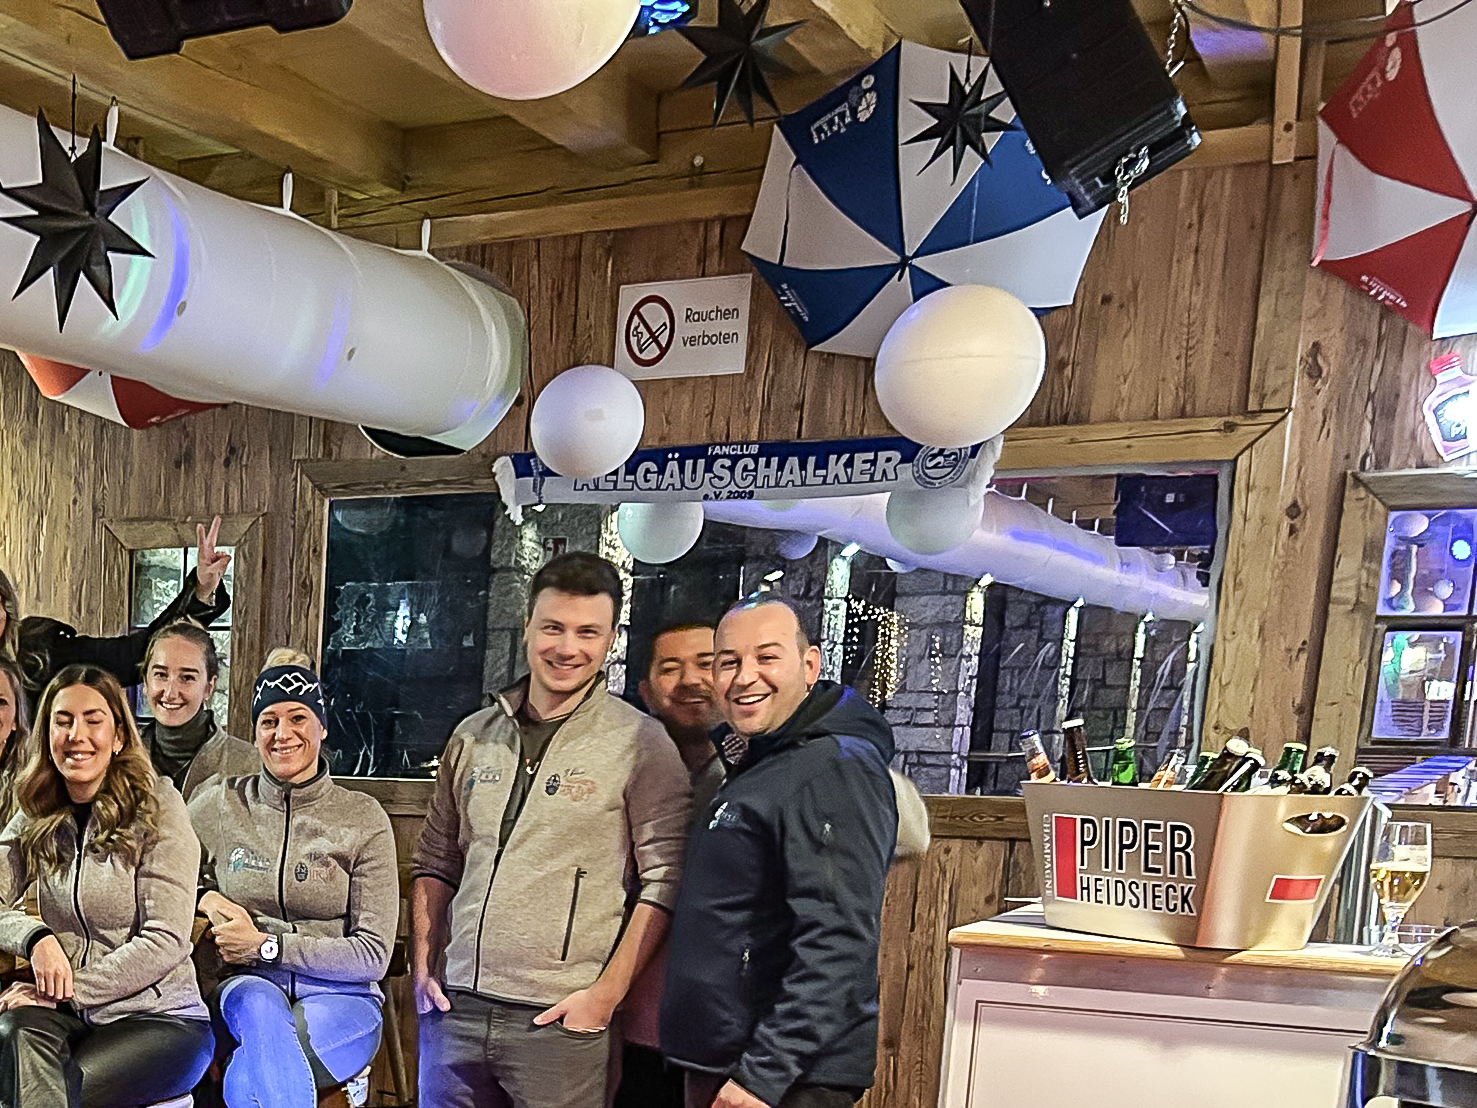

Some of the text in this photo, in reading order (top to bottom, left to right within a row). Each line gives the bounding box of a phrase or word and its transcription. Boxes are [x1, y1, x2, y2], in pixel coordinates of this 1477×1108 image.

[685, 305, 740, 323] Rauchen
[682, 330, 739, 347] verboten
[708, 444, 760, 456] FANCLUB
[709, 450, 902, 490] SCHALKER
[726, 489, 755, 500] 2009
[1078, 815, 1197, 879] PIPER
[1078, 873, 1197, 917] HEIDSIECK
